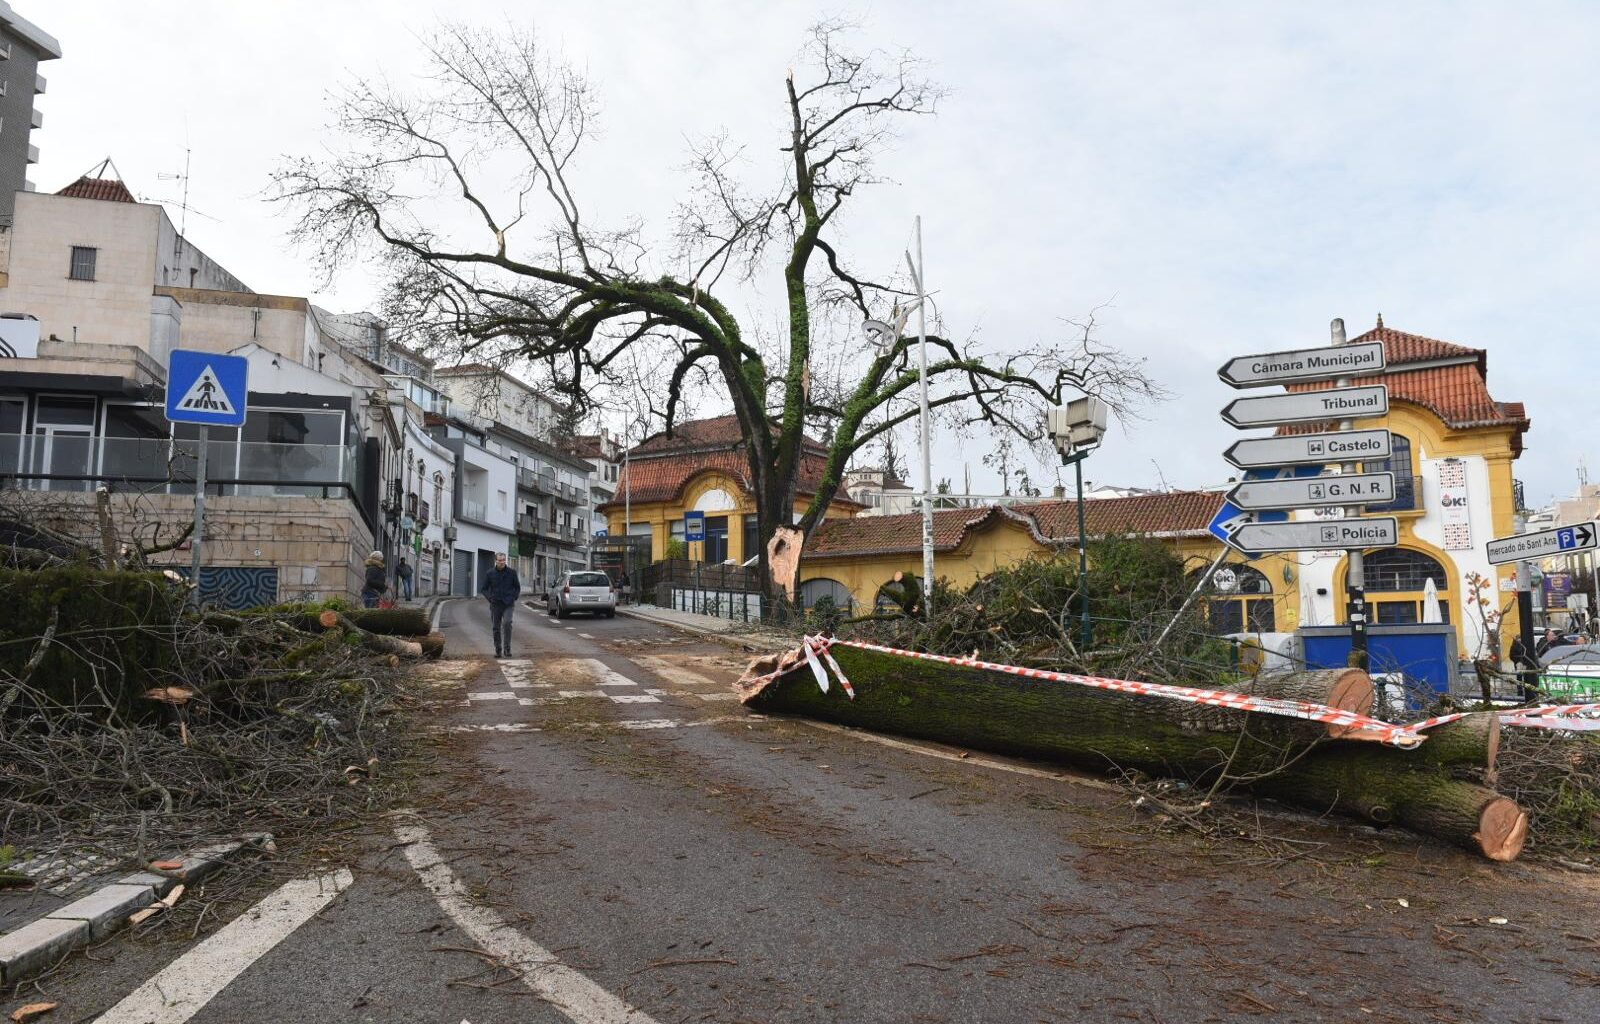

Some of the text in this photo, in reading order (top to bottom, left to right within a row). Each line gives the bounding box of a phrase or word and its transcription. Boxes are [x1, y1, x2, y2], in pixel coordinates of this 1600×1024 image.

[1252, 351, 1375, 374] Câmara Municipal
[1321, 395, 1378, 410] Tribunal
[1328, 438, 1381, 452] Castelo
[1329, 482, 1385, 496] G. N. R.
[1442, 496, 1467, 508] OK!
[1342, 527, 1387, 540] Polícia
[1490, 545, 1516, 556] mercado
[1518, 542, 1525, 551] de
